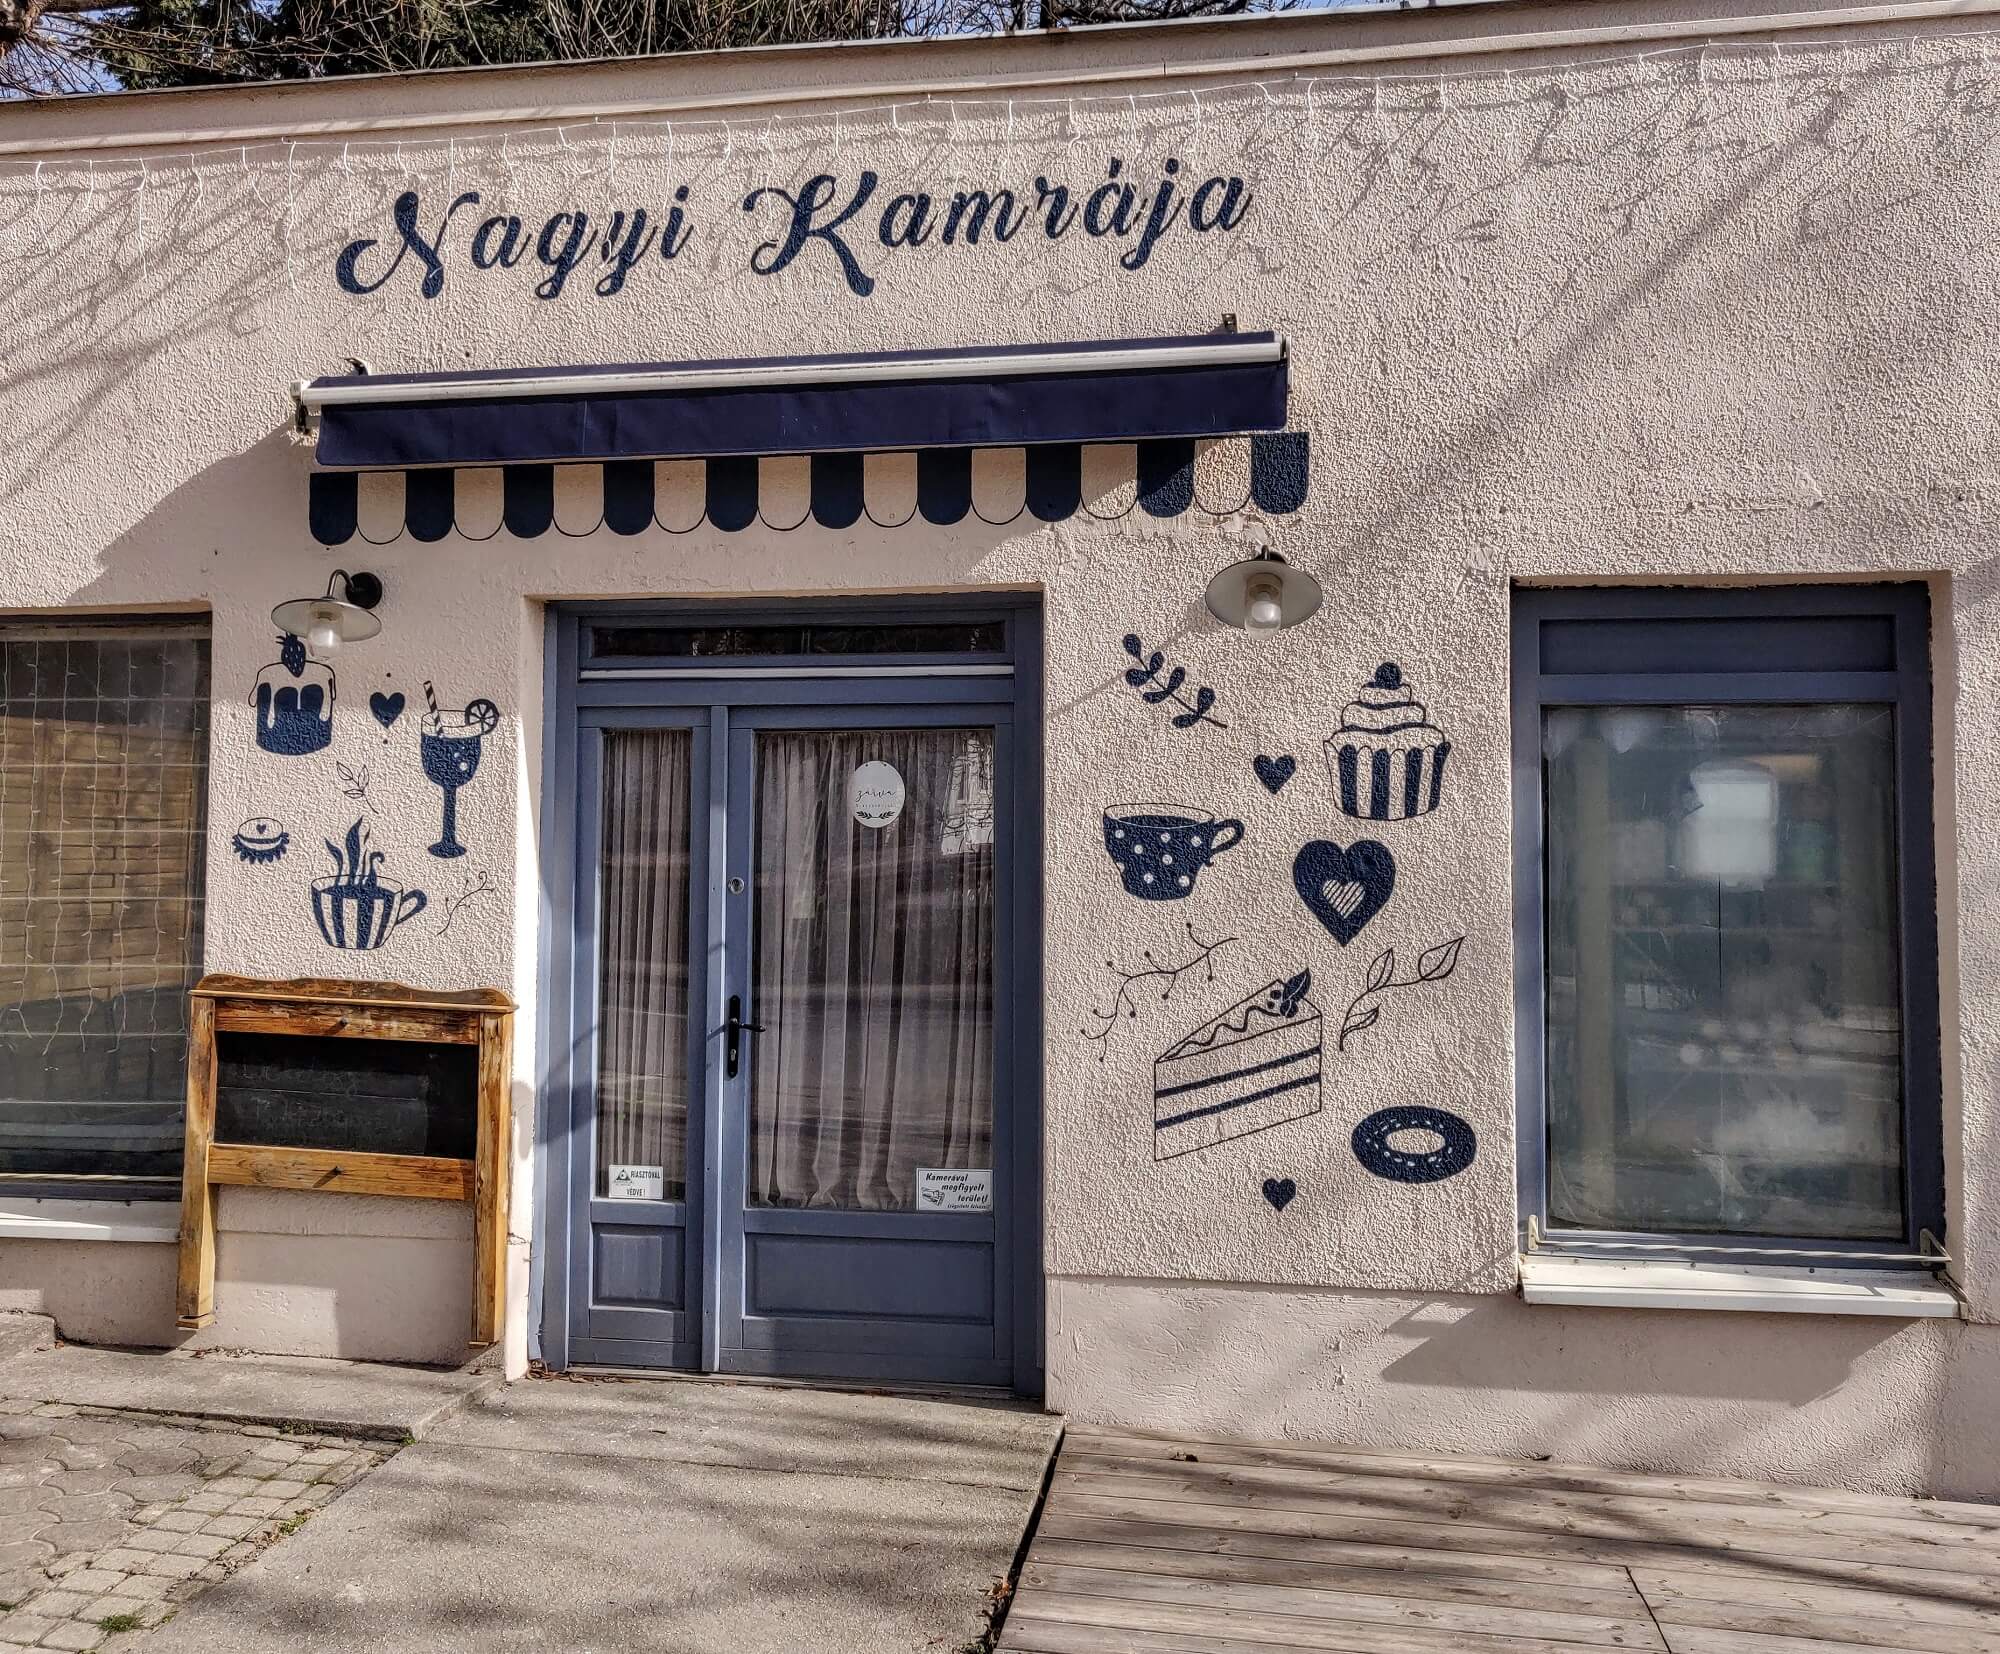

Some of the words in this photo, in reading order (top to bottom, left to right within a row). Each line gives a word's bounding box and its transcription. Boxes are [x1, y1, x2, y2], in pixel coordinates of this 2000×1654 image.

[335, 185, 694, 300] Nagyi
[742, 156, 1253, 297] Kamrája
[941, 1182, 985, 1193] megfigyelt
